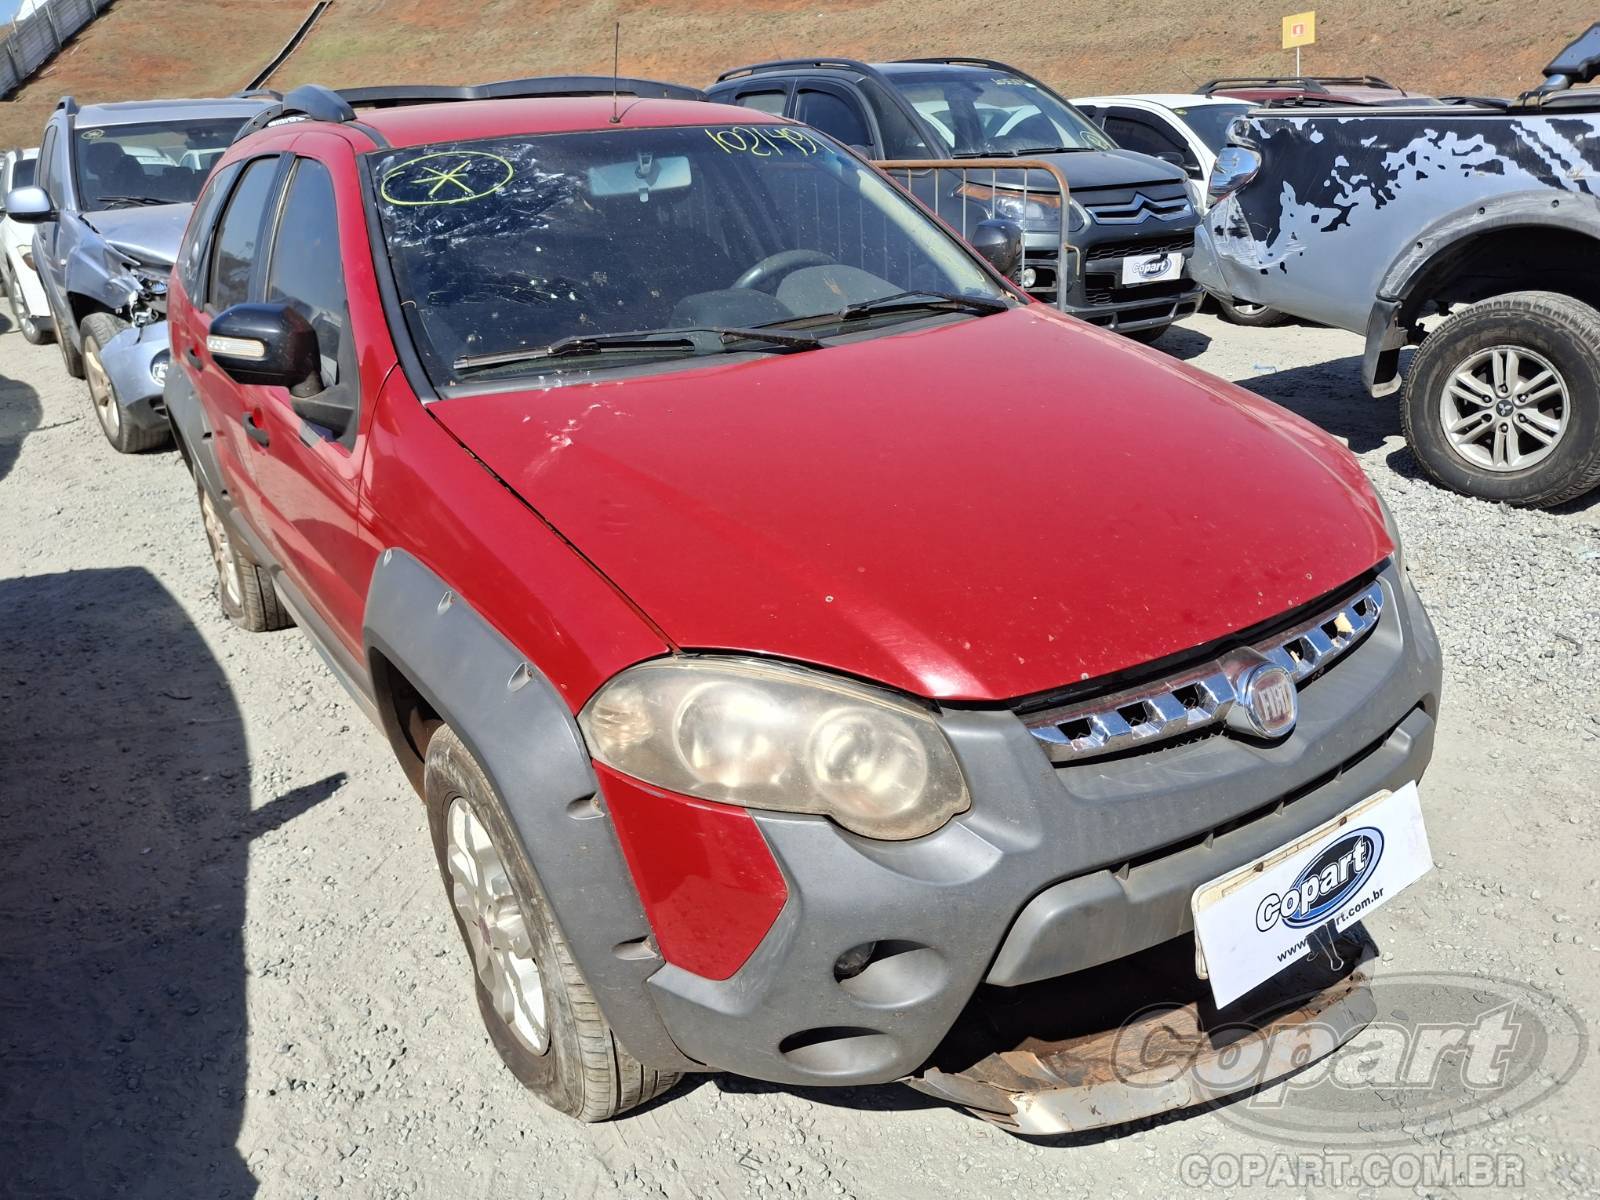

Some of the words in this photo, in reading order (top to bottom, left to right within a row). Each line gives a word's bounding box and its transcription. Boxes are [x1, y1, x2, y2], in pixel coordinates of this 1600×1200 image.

[1132, 260, 1167, 273] Copart
[1259, 682, 1290, 720] FIAT
[1256, 835, 1368, 932] Copart
